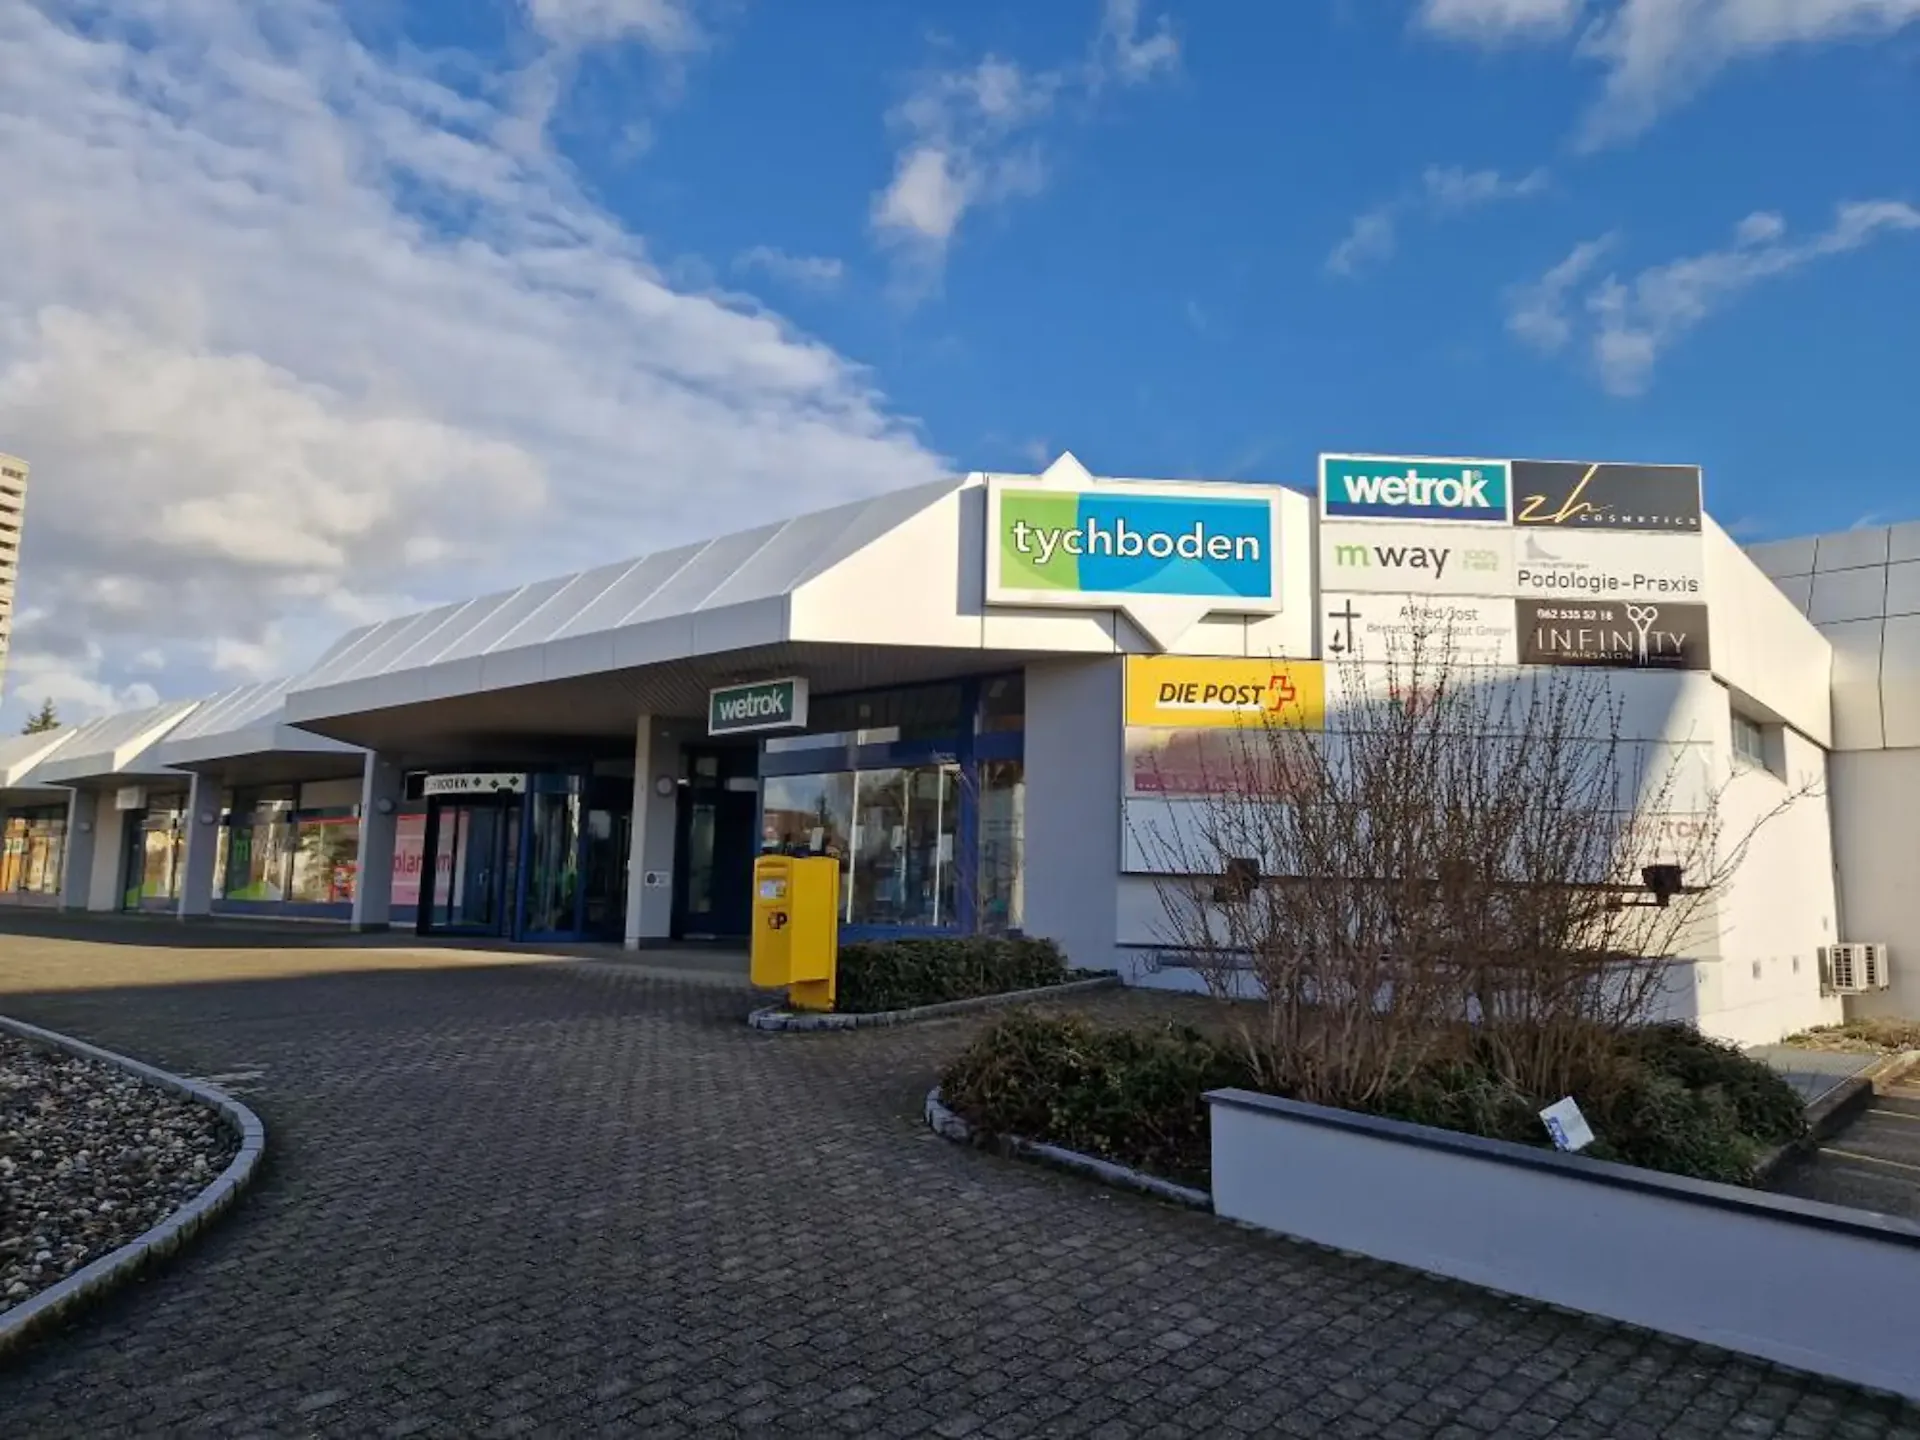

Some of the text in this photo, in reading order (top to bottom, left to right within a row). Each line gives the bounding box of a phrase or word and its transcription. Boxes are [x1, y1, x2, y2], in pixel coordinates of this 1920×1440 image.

[1343, 469, 1491, 508] wetrok
[1580, 514, 1698, 526] COSMETICS
[1013, 517, 1260, 565] tychboden
[1517, 570, 1699, 594] Podologie-Praxis
[720, 687, 785, 722] wetrok
[1159, 683, 1266, 705] DIE POST
